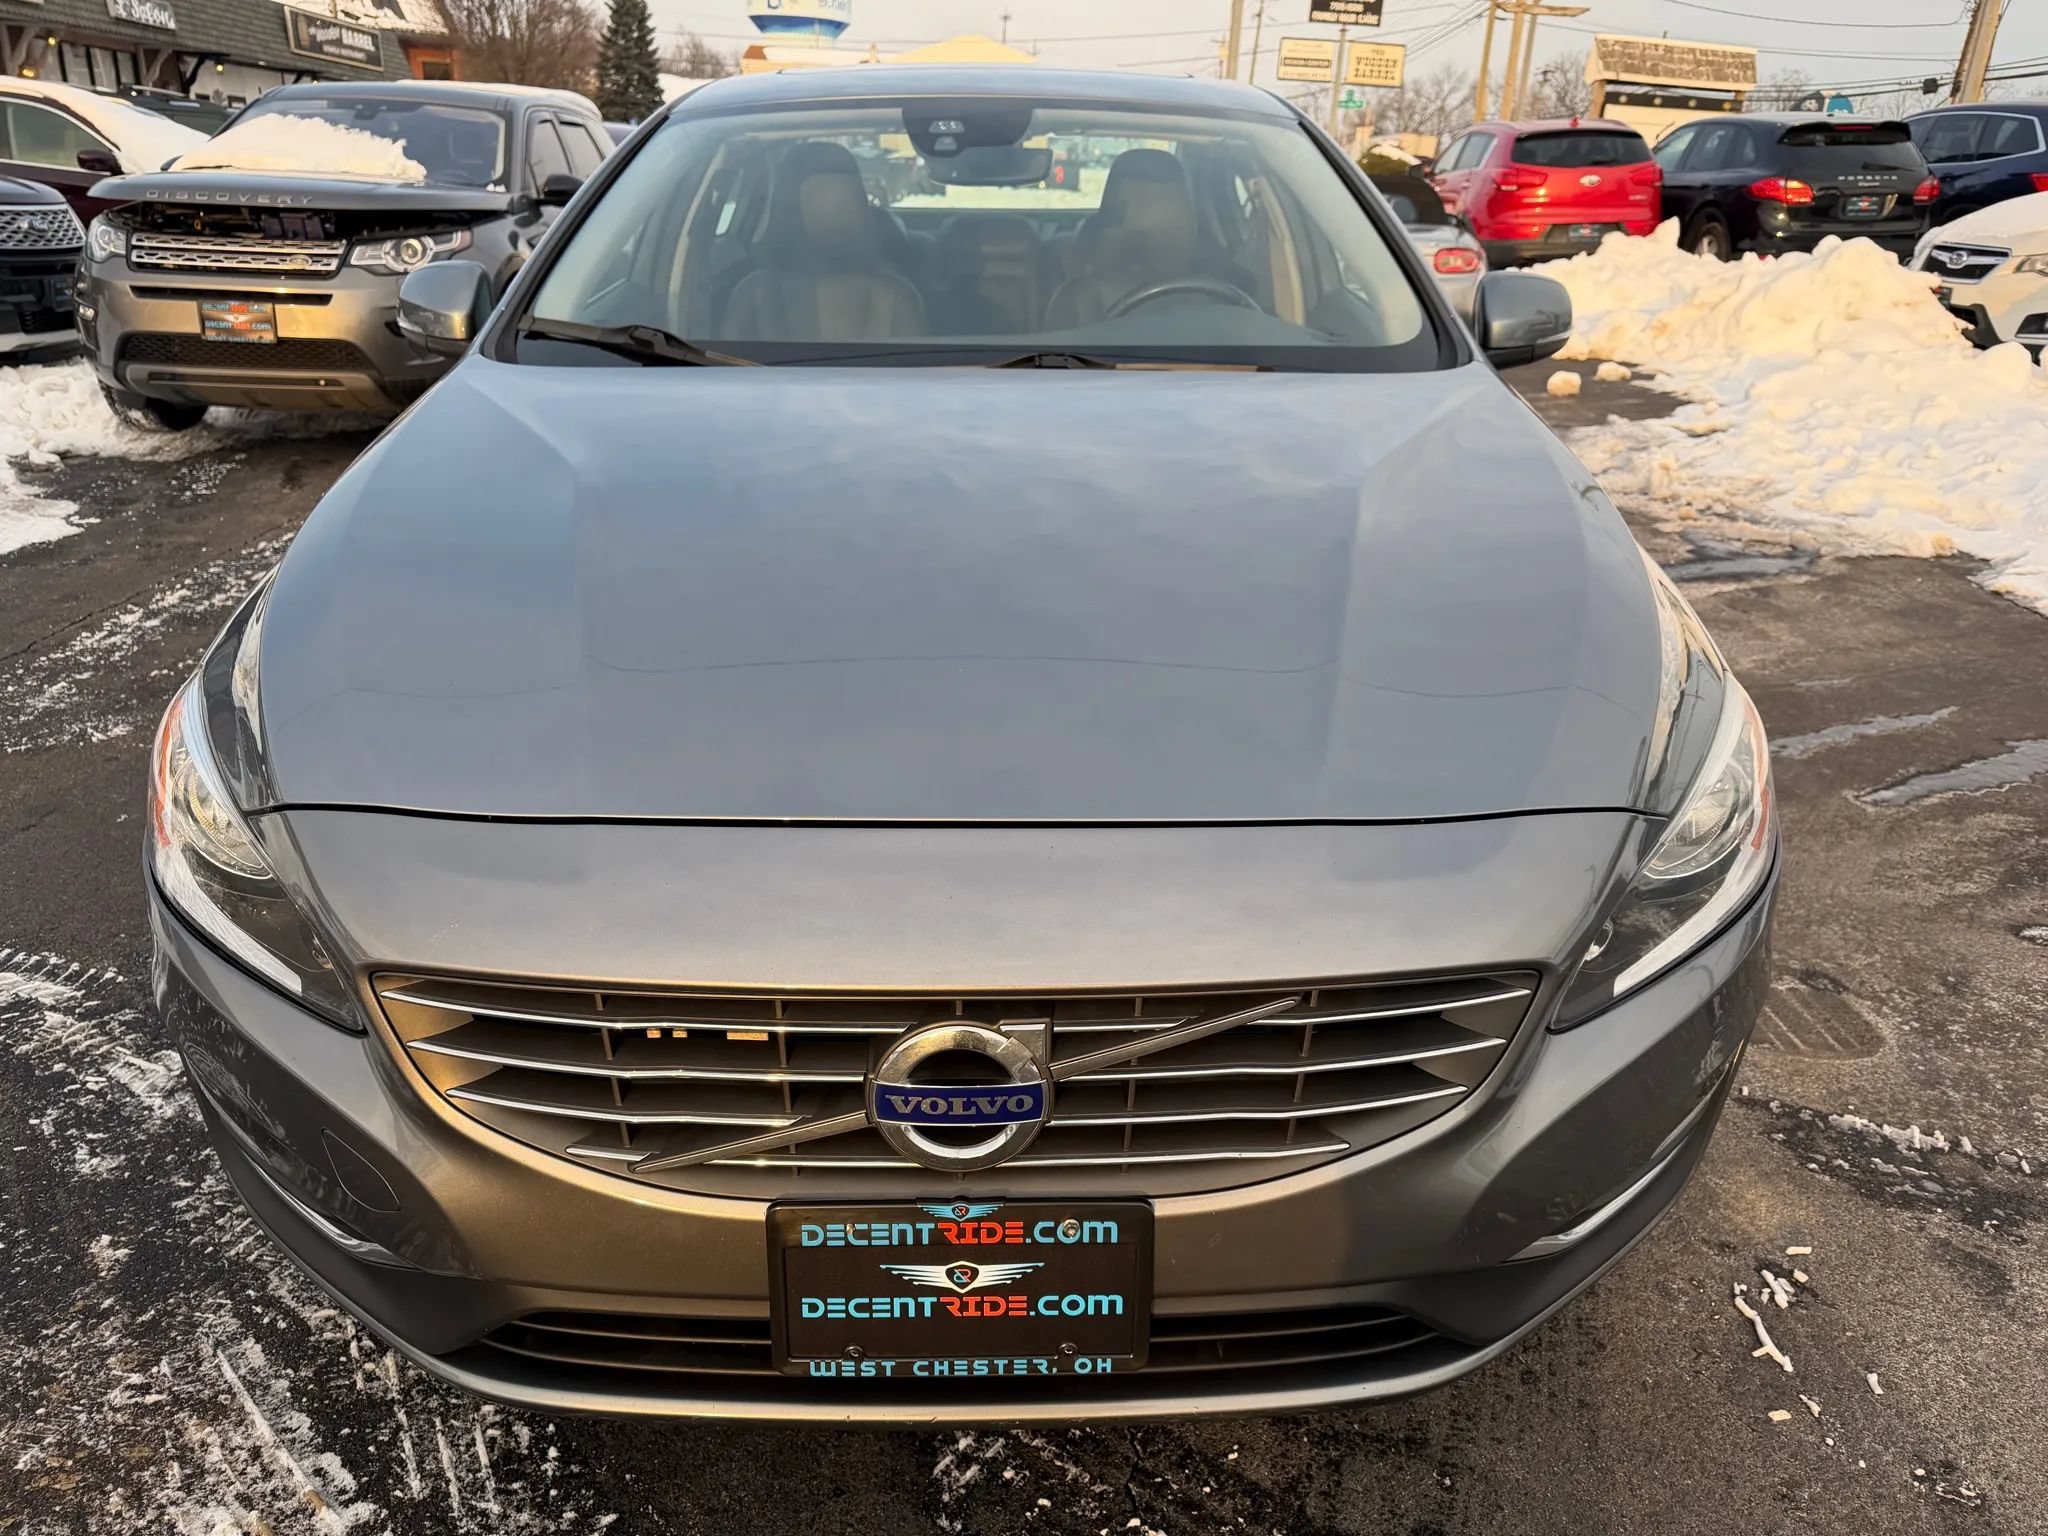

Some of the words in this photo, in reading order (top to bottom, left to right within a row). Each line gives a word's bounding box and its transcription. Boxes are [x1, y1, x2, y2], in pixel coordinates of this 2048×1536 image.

[146, 188, 313, 205] DISCOVERY
[885, 1094, 1034, 1115] VOLVO
[802, 1294, 1124, 1319] DECENTRIDE.COM
[809, 1360, 896, 1377] WEST
[912, 1358, 1058, 1376] CHESTER,
[1074, 1358, 1112, 1374] OH
